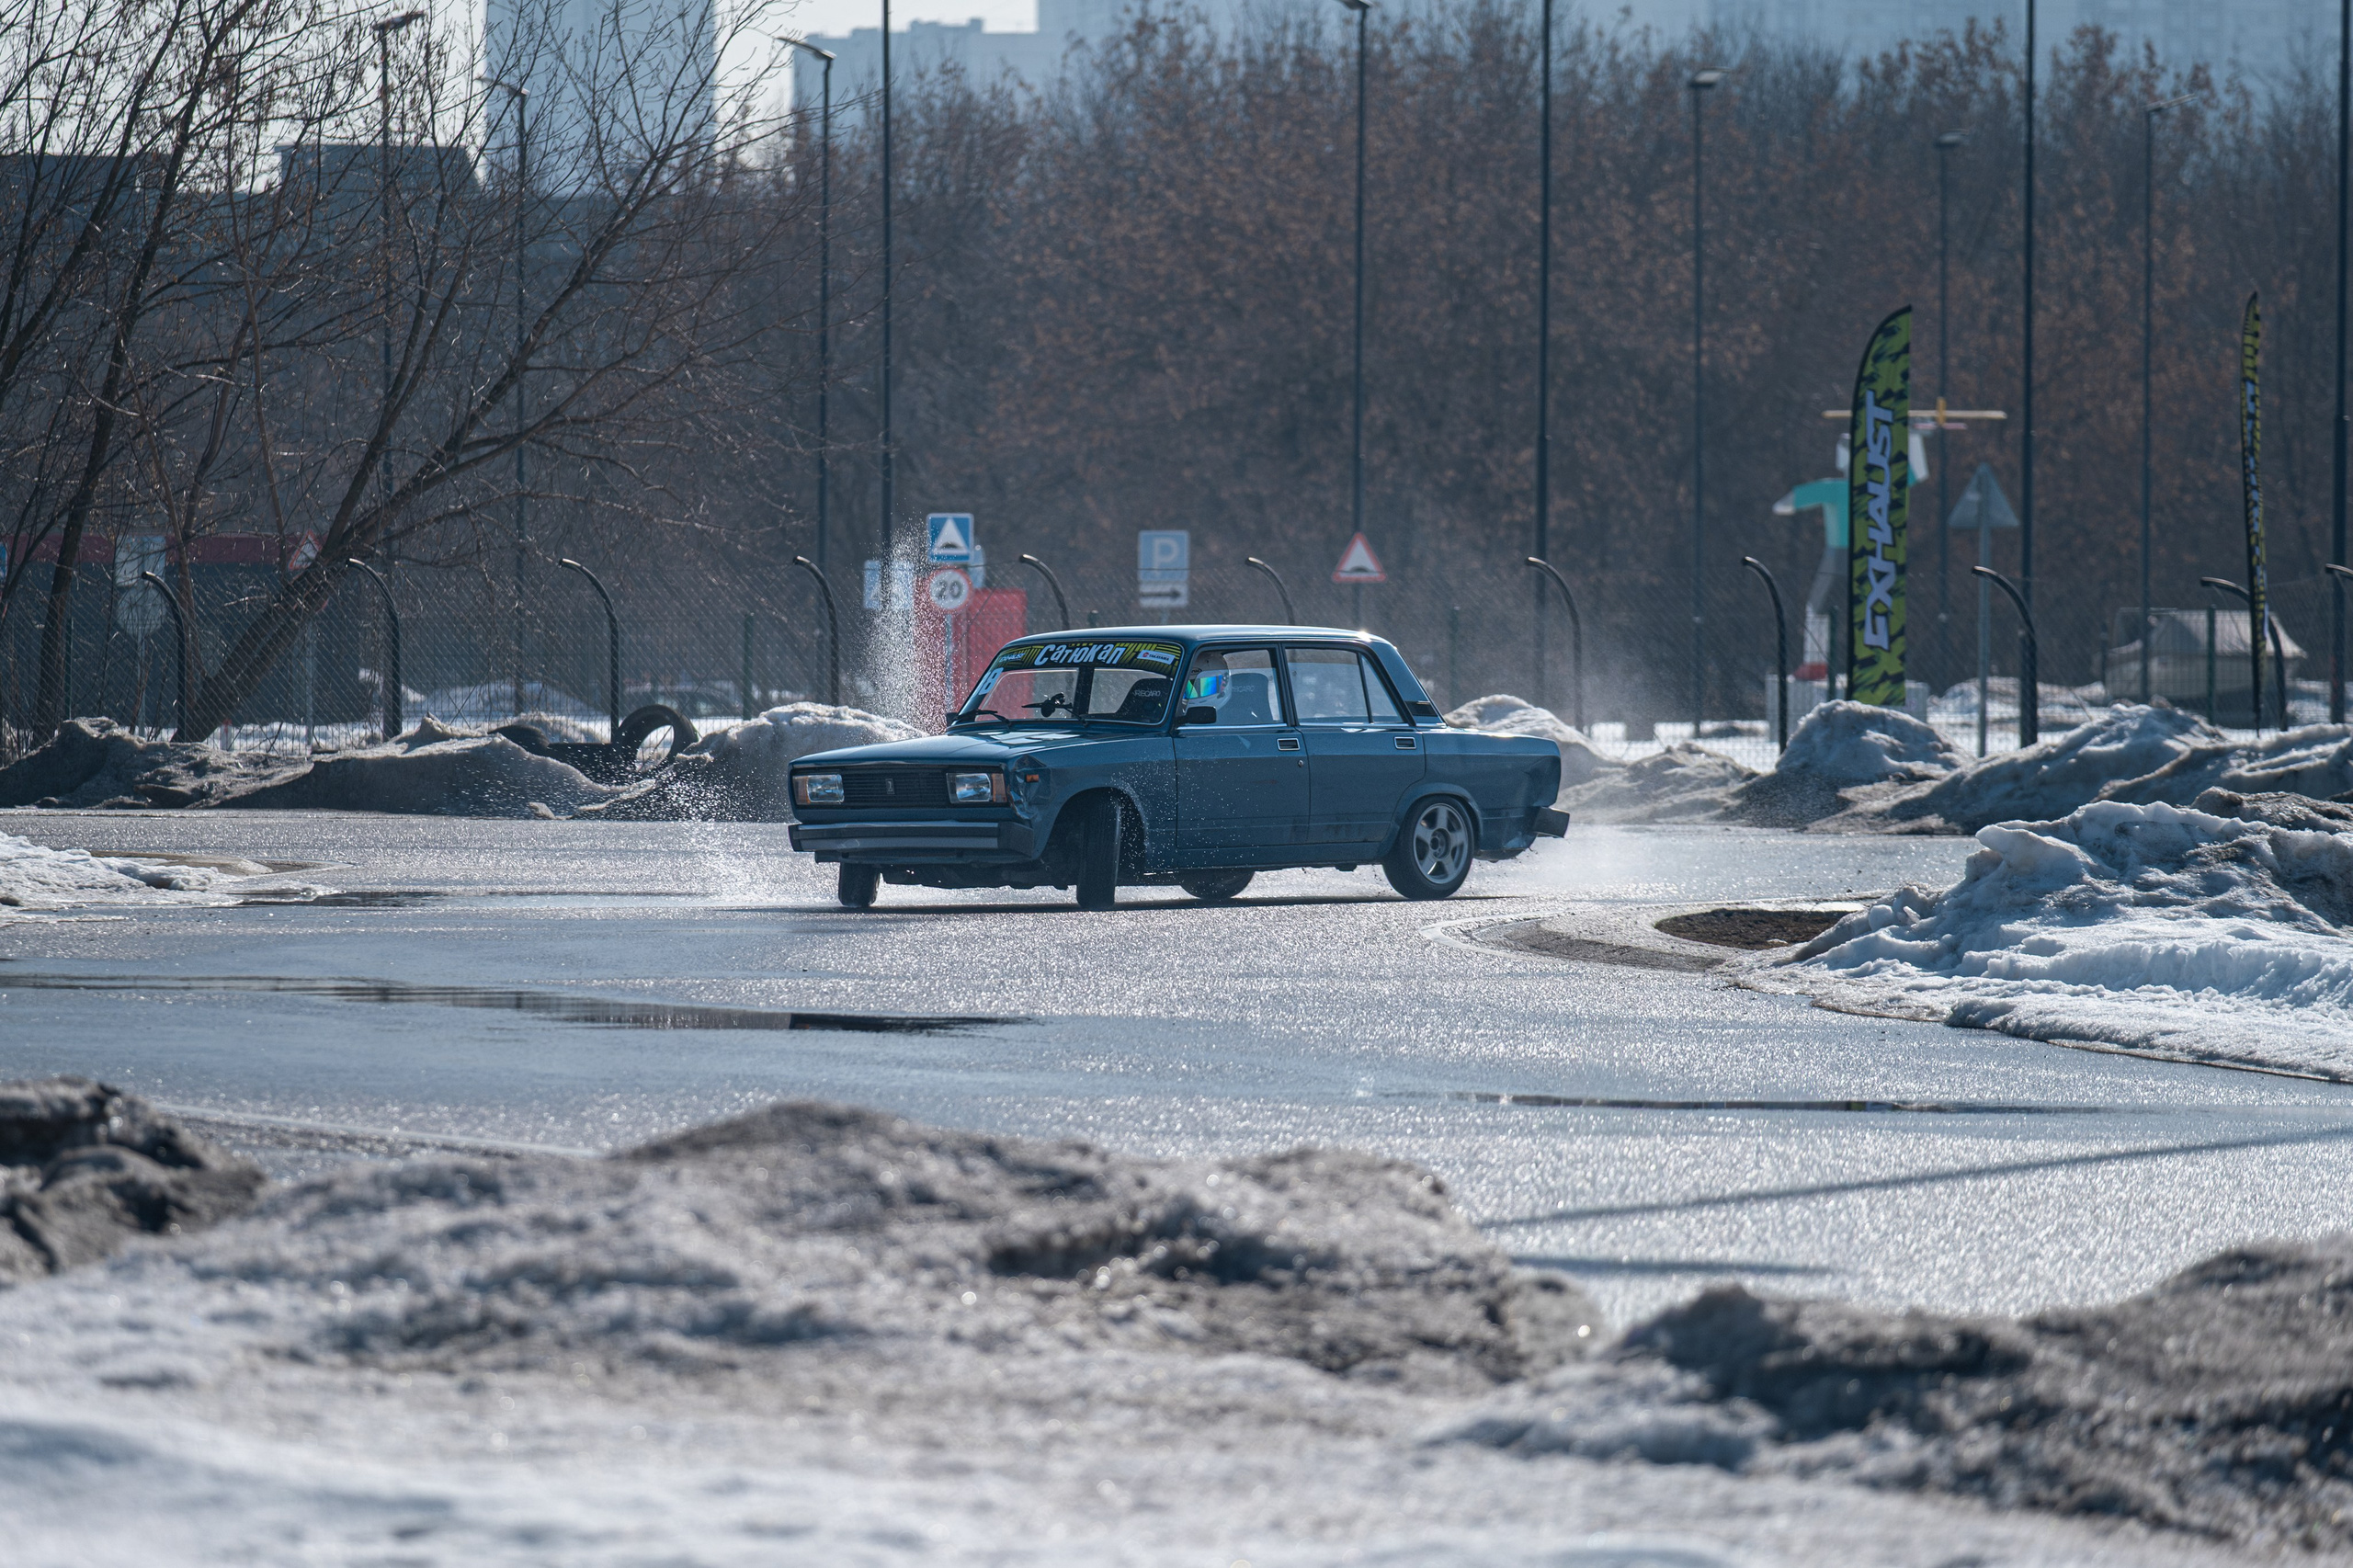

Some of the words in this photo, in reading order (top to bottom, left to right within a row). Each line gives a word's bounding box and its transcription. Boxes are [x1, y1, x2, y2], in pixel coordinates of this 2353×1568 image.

[1864, 390, 1896, 651] EXHAUST
[1154, 538, 1179, 575] P
[936, 580, 962, 601] 20
